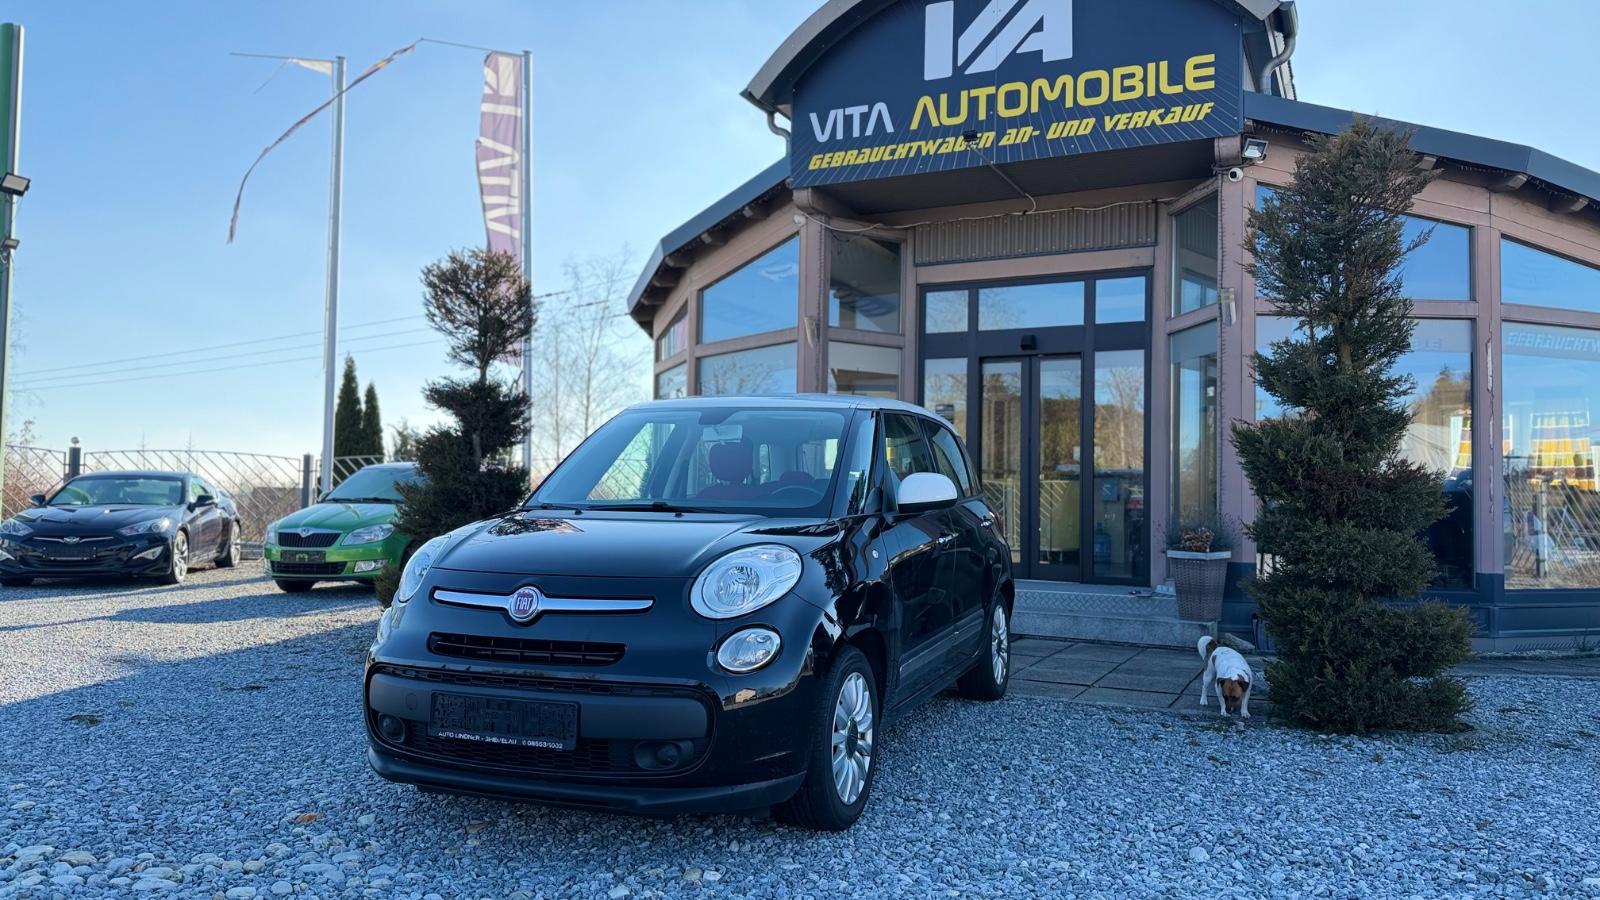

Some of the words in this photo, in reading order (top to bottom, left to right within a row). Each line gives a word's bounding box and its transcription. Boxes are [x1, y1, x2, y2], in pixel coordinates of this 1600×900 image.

[809, 102, 894, 143] VITA
[910, 54, 1216, 130] AUTOMOBILE
[1046, 117, 1096, 140] UND
[1104, 102, 1214, 132] VERKAUF
[516, 596, 533, 610] FIAT
